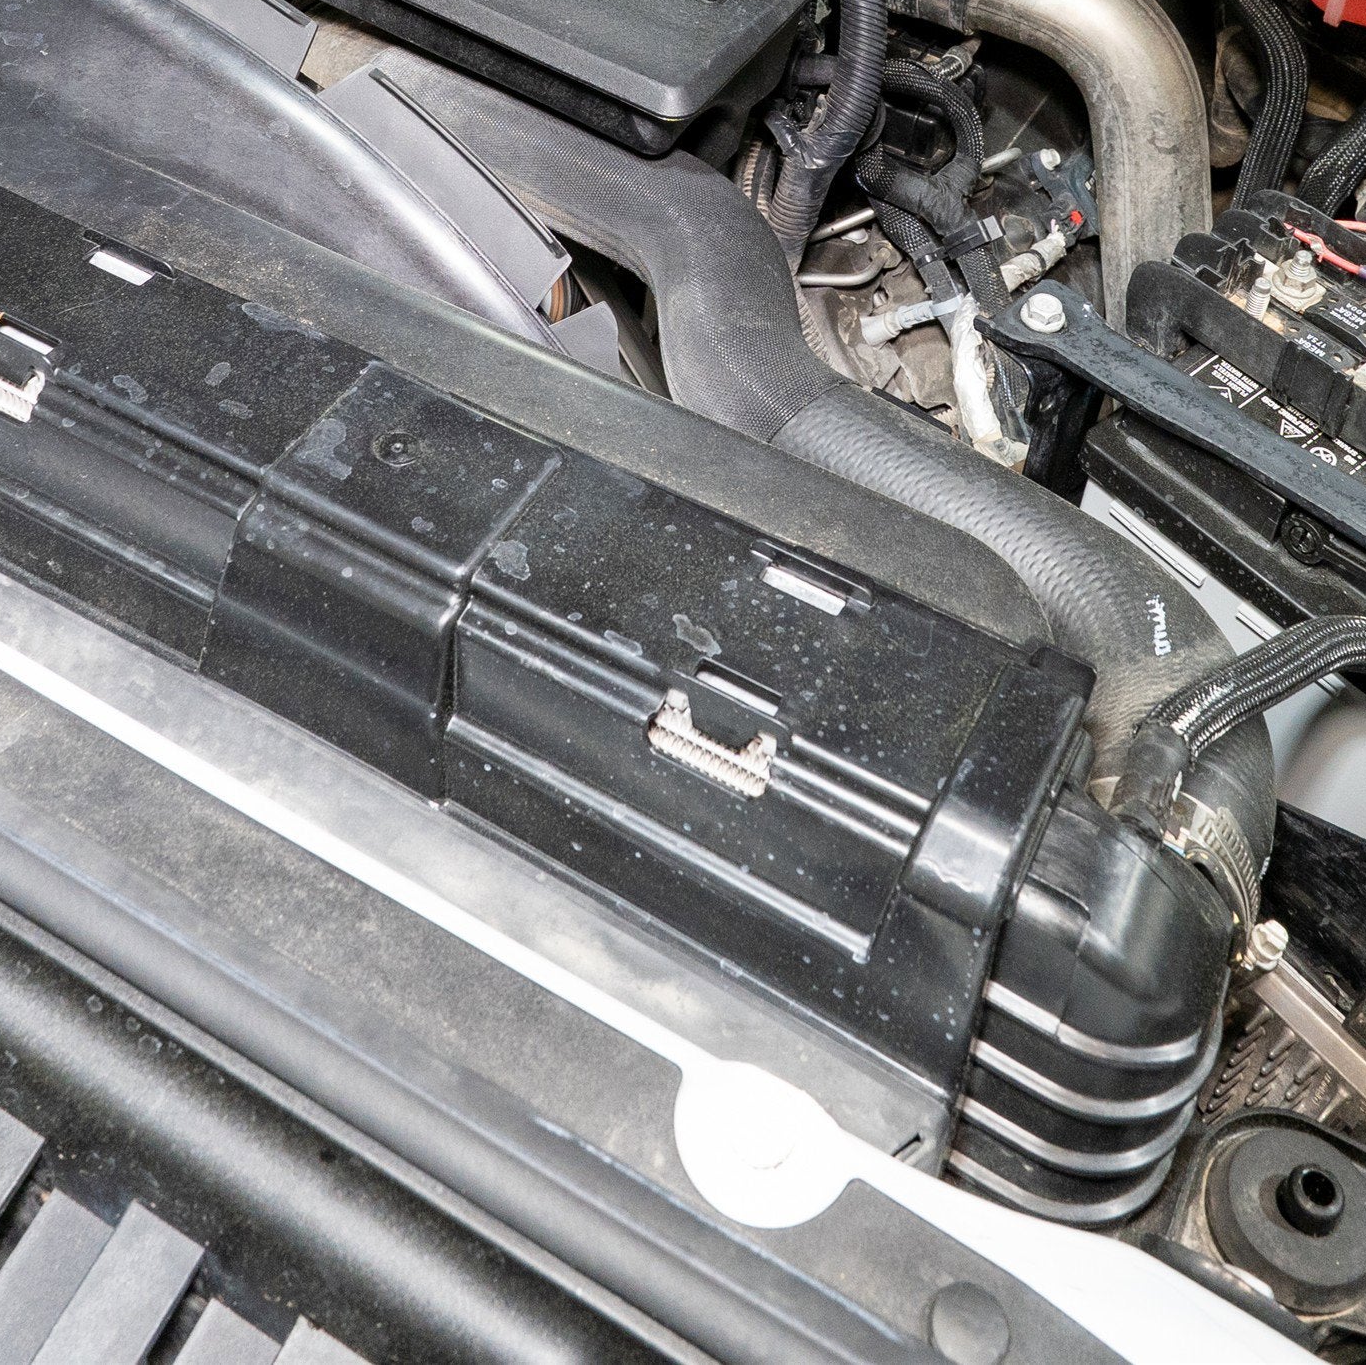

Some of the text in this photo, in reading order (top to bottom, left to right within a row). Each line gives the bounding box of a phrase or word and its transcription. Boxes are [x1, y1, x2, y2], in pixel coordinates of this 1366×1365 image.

[1306, 334, 1327, 348] 175A
[1211, 370, 1249, 397] FLUSH EYES
[1260, 395, 1314, 433] SULFURIC ACID
[1342, 454, 1357, 465] NO
